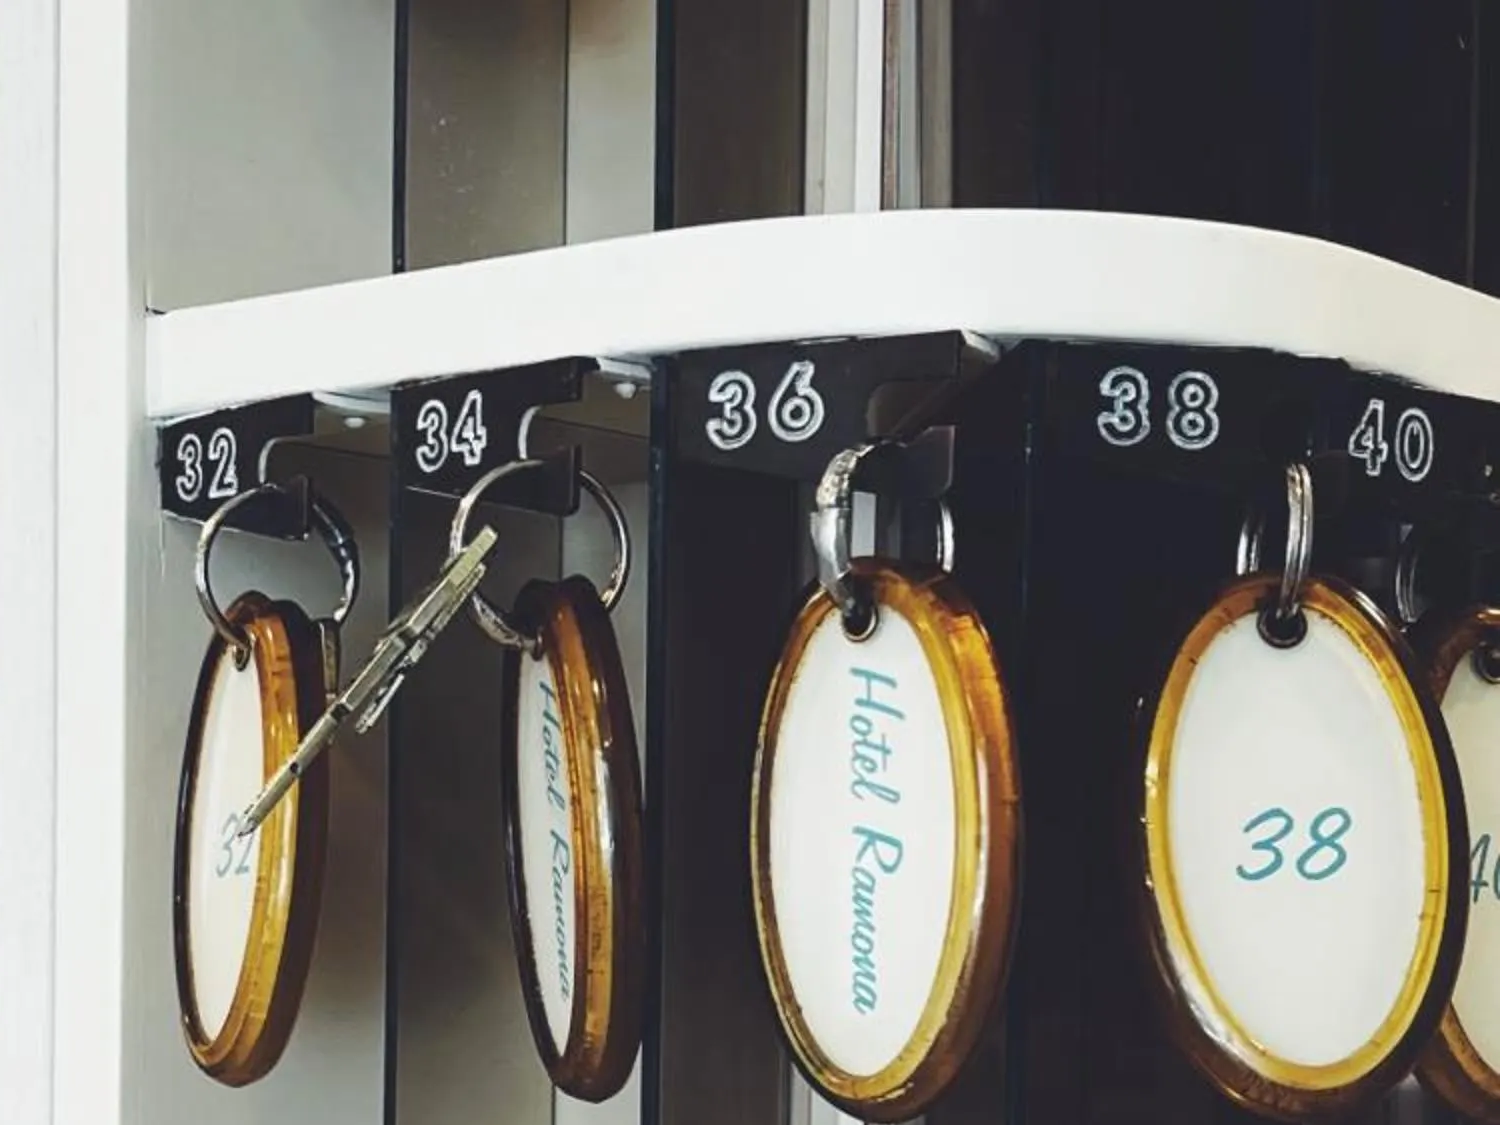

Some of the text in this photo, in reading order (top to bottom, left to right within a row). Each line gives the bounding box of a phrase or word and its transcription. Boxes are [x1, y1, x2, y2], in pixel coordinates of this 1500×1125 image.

[415, 389, 488, 472] 34
[705, 361, 825, 450] 36
[1098, 367, 1220, 449] 38
[1348, 398, 1435, 482] 40
[175, 427, 238, 501] 32
[539, 680, 566, 813] Hotel
[849, 666, 905, 1015] Hotel Ramona
[1235, 806, 1353, 881] 38
[1470, 833, 1500, 904] 4
